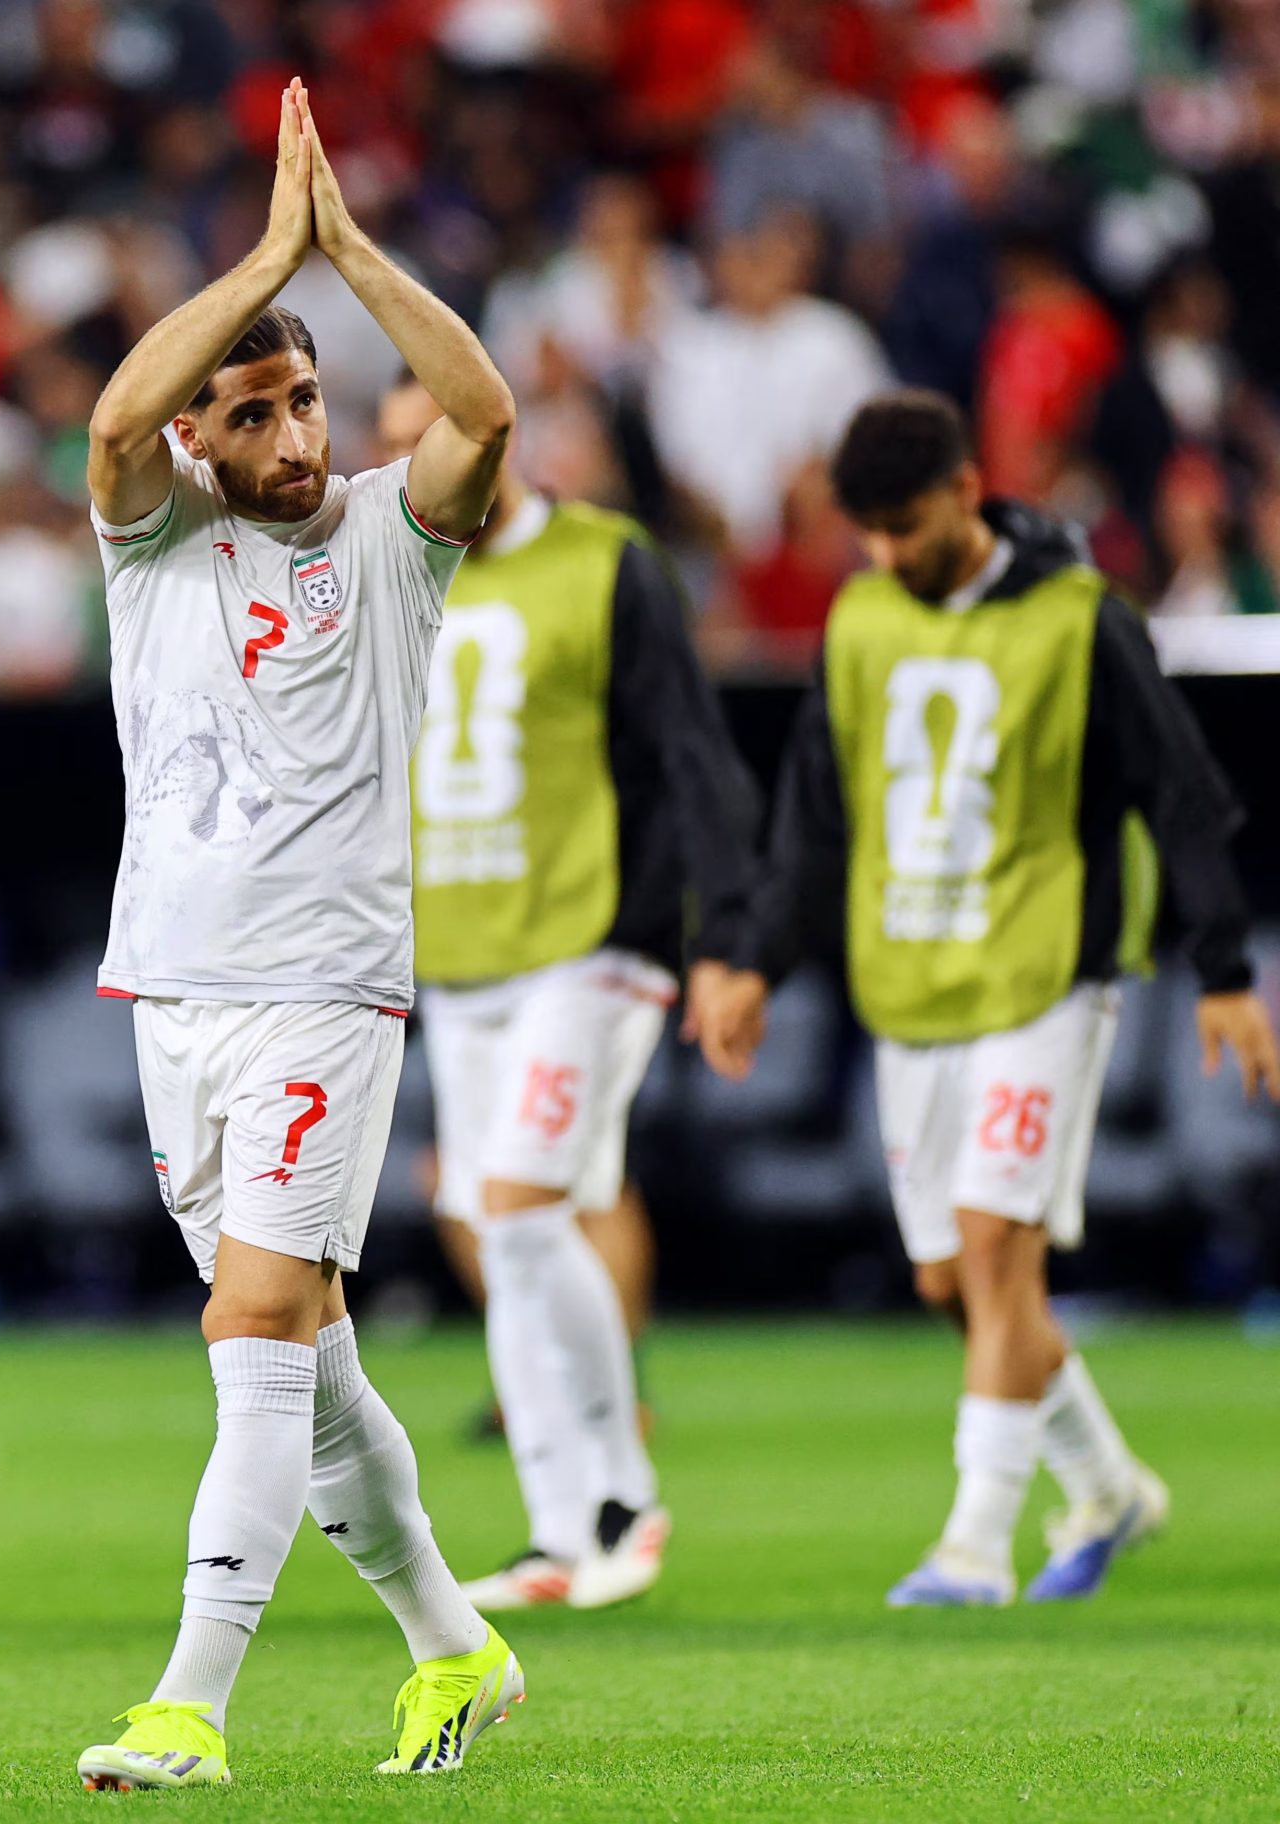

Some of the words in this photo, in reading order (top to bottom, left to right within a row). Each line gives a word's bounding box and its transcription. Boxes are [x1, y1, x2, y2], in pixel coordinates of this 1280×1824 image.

[242, 601, 289, 678] 7
[282, 1082, 328, 1165] 7
[979, 1082, 1051, 1158] 26
